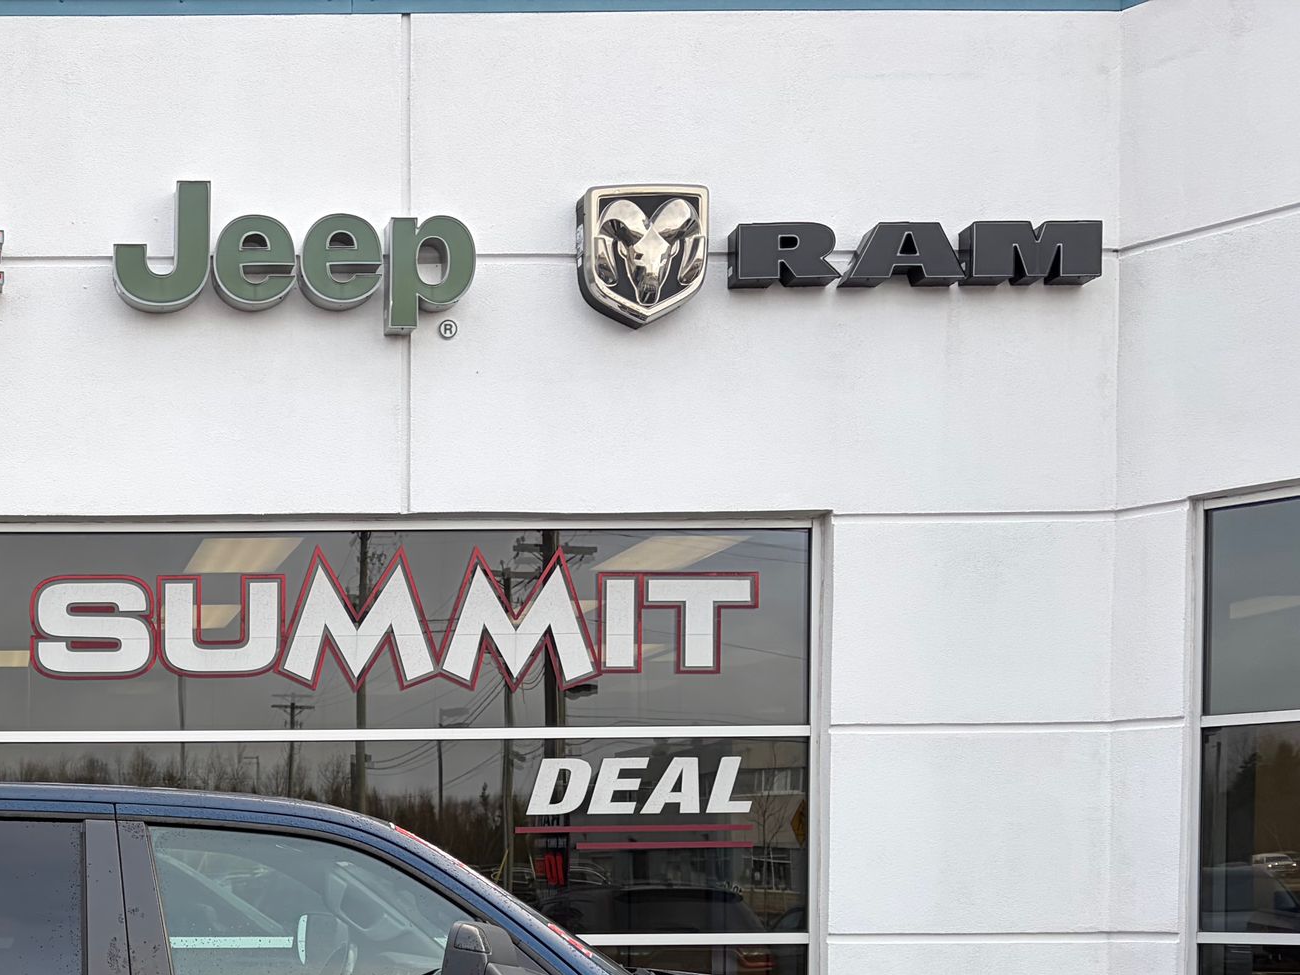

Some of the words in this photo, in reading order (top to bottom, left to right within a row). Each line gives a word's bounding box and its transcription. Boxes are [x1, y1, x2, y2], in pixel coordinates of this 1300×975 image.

[113, 180, 477, 337] Jeep
[728, 219, 1104, 290] RAM
[29, 545, 760, 694] SUMMIT
[526, 757, 753, 815] DEAL
